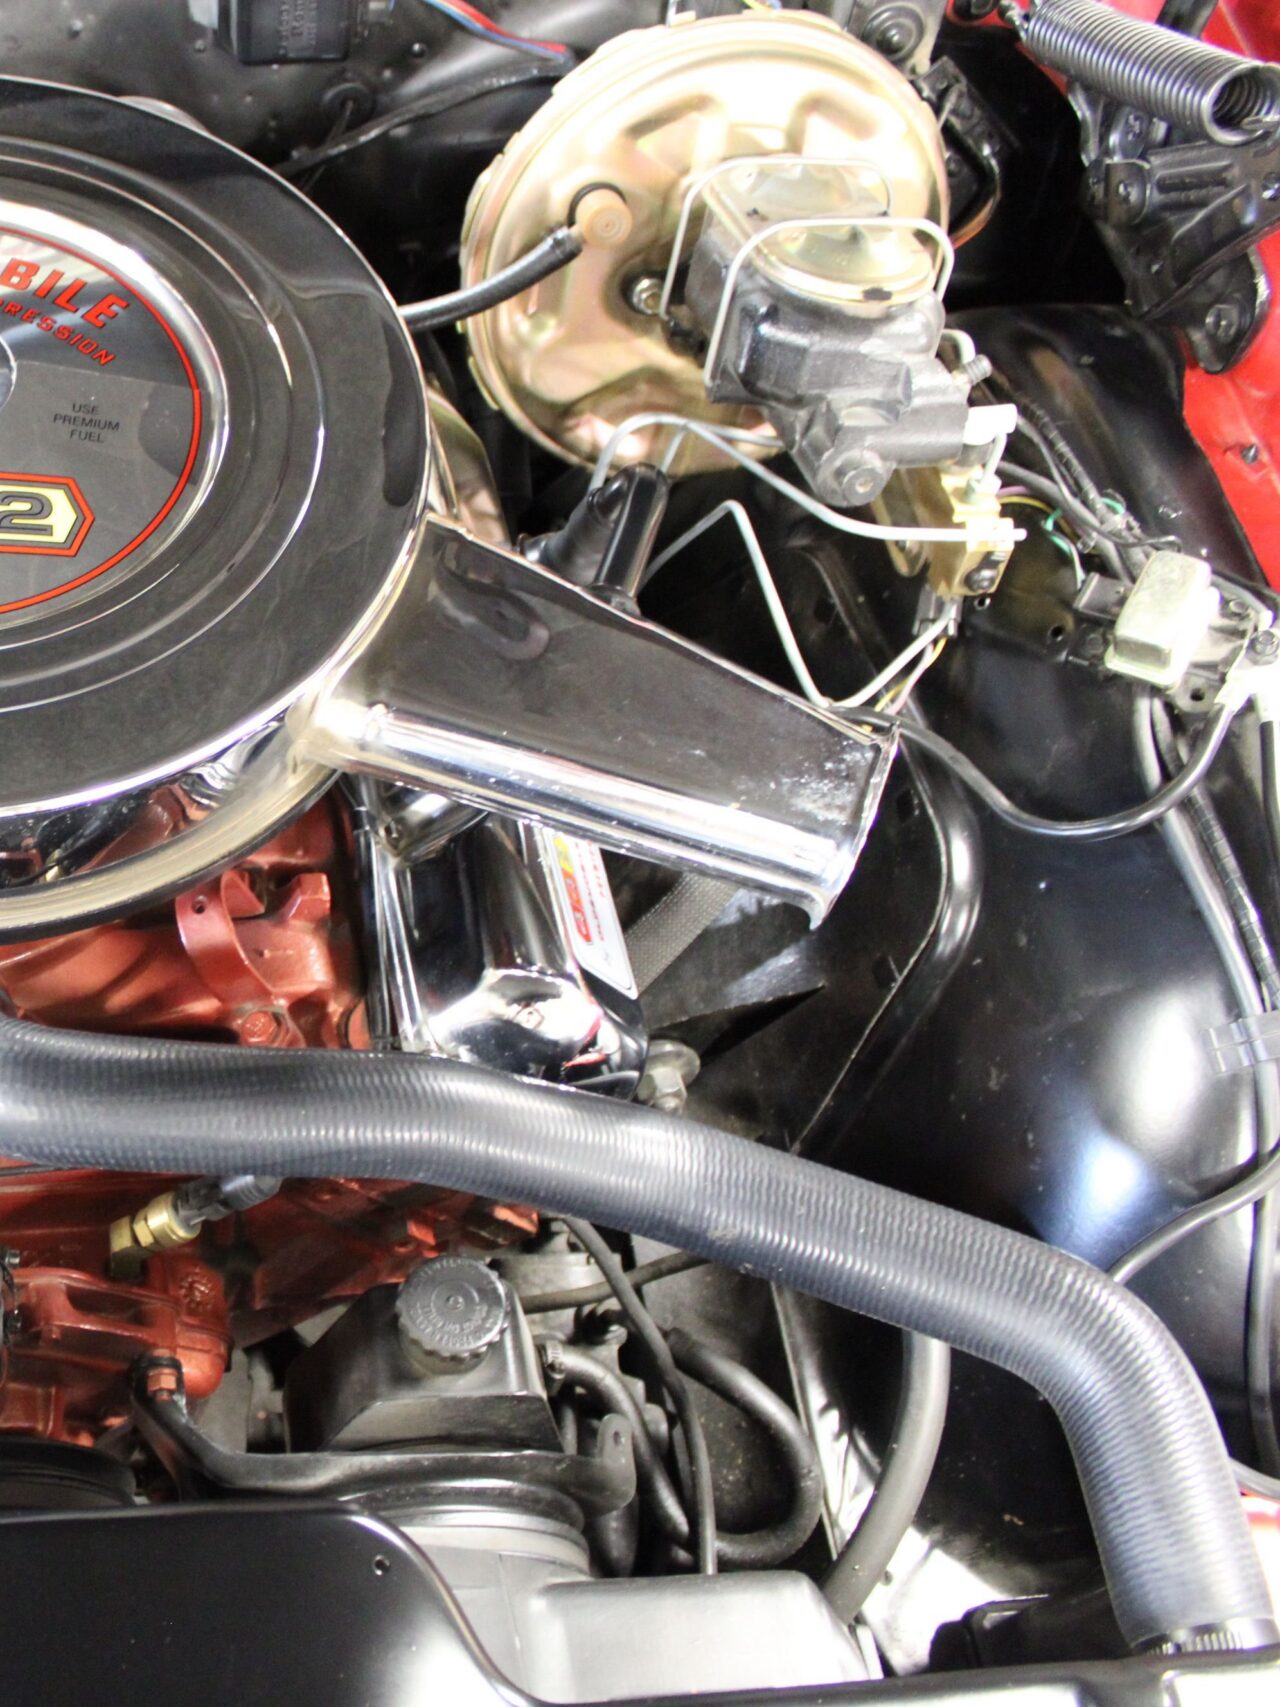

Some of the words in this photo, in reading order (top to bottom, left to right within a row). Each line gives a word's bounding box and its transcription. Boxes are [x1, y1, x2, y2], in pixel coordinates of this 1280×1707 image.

[72, 403, 99, 416] USE
[53, 413, 120, 432] PREMIUM
[70, 429, 105, 443] FUEL
